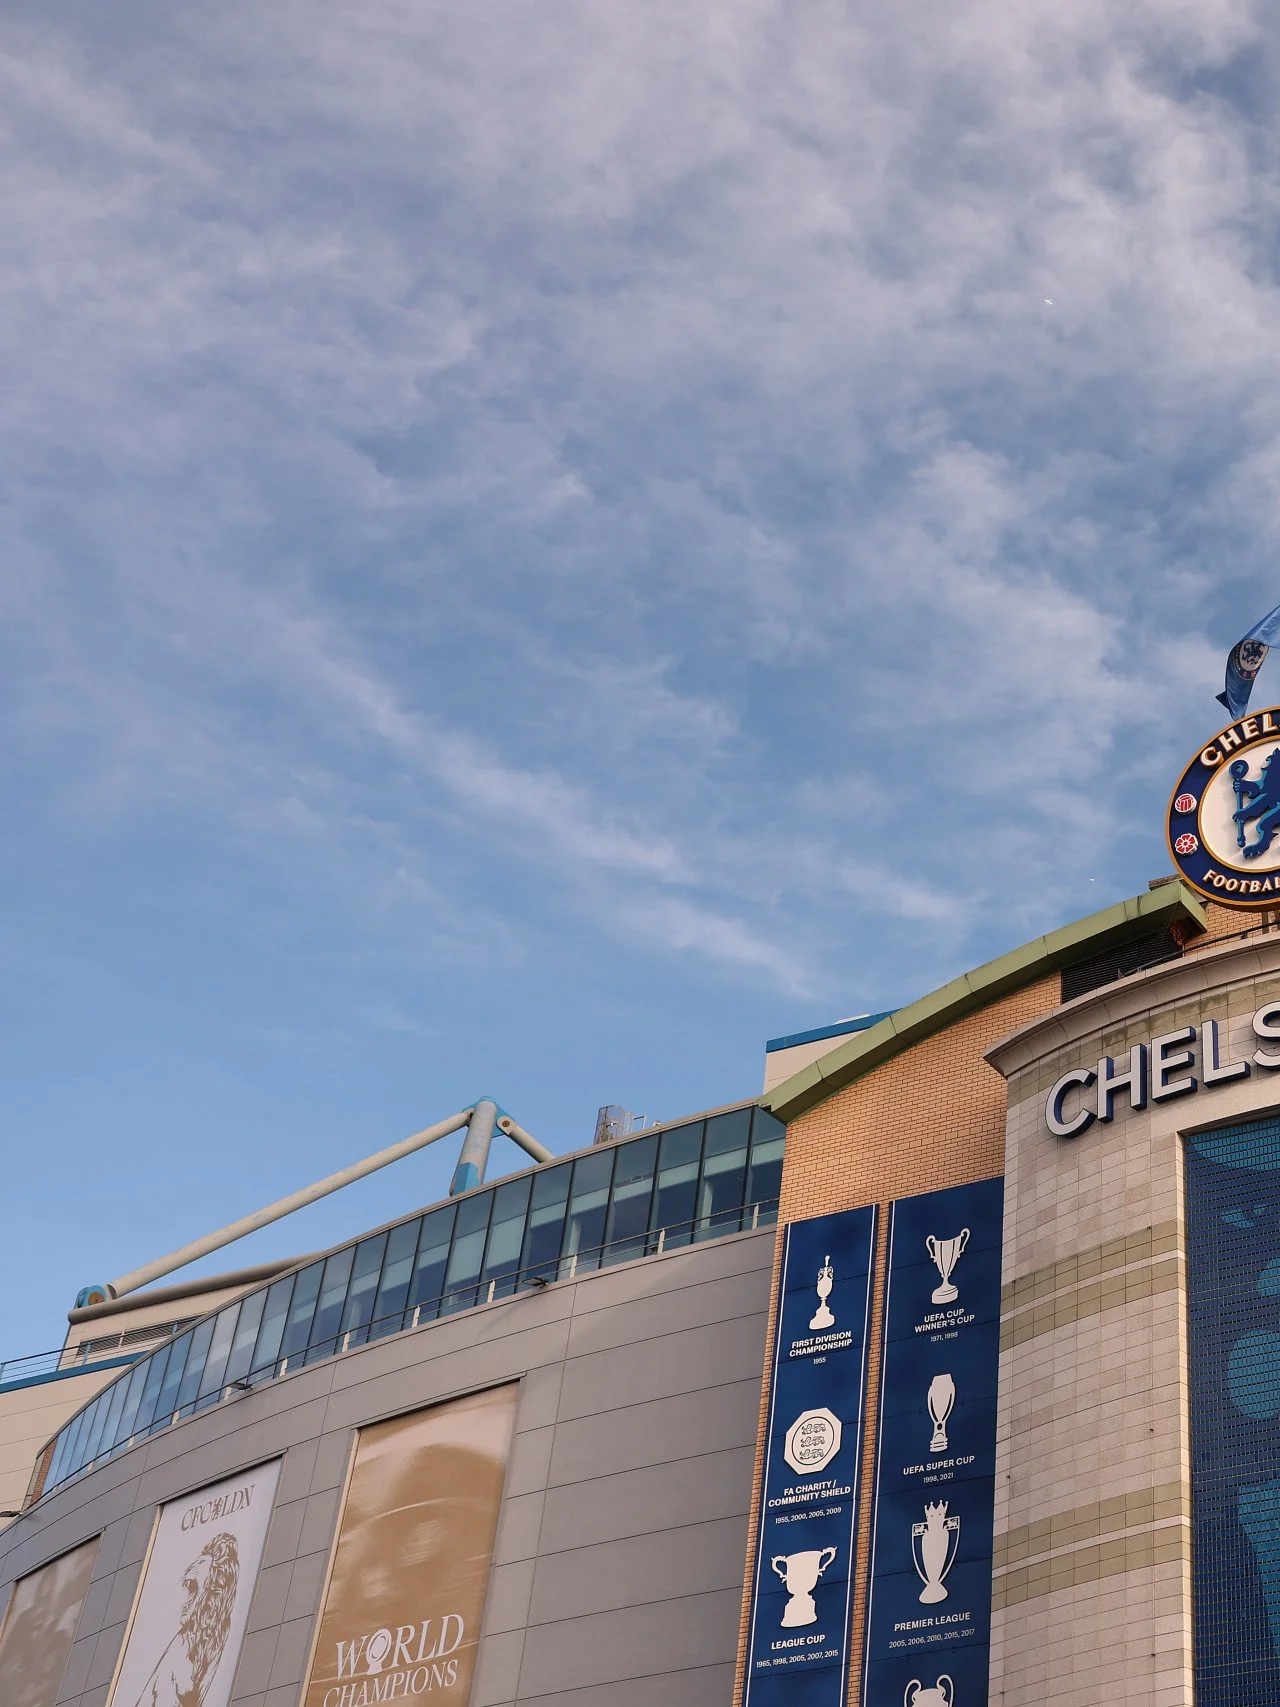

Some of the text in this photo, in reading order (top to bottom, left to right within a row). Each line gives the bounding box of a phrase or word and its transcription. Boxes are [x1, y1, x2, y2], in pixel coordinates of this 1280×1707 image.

[914, 1314, 975, 1333] WINNER'S CUP
[924, 1308, 965, 1323] UEFA CUP
[789, 1338, 853, 1357] CHAMPIONSHIP
[792, 1330, 852, 1349] FIRST DIVISION
[903, 1455, 975, 1475] UEFA SUPER CUP
[940, 1472, 954, 1481] 2021
[768, 1486, 851, 1507] COMMUNITY SHIELD
[784, 1488, 794, 1496] FA
[795, 1480, 832, 1494] CHARITY
[826, 1507, 842, 1515] 2009
[894, 1612, 971, 1632] PREMIER LEAGUE
[771, 1634, 825, 1650] LEAGUE CUP
[961, 1629, 975, 1637] 2017
[336, 1613, 464, 1680] WORLD
[824, 1649, 839, 1658] 2015
[323, 1659, 458, 1707] CHAMPIONS
